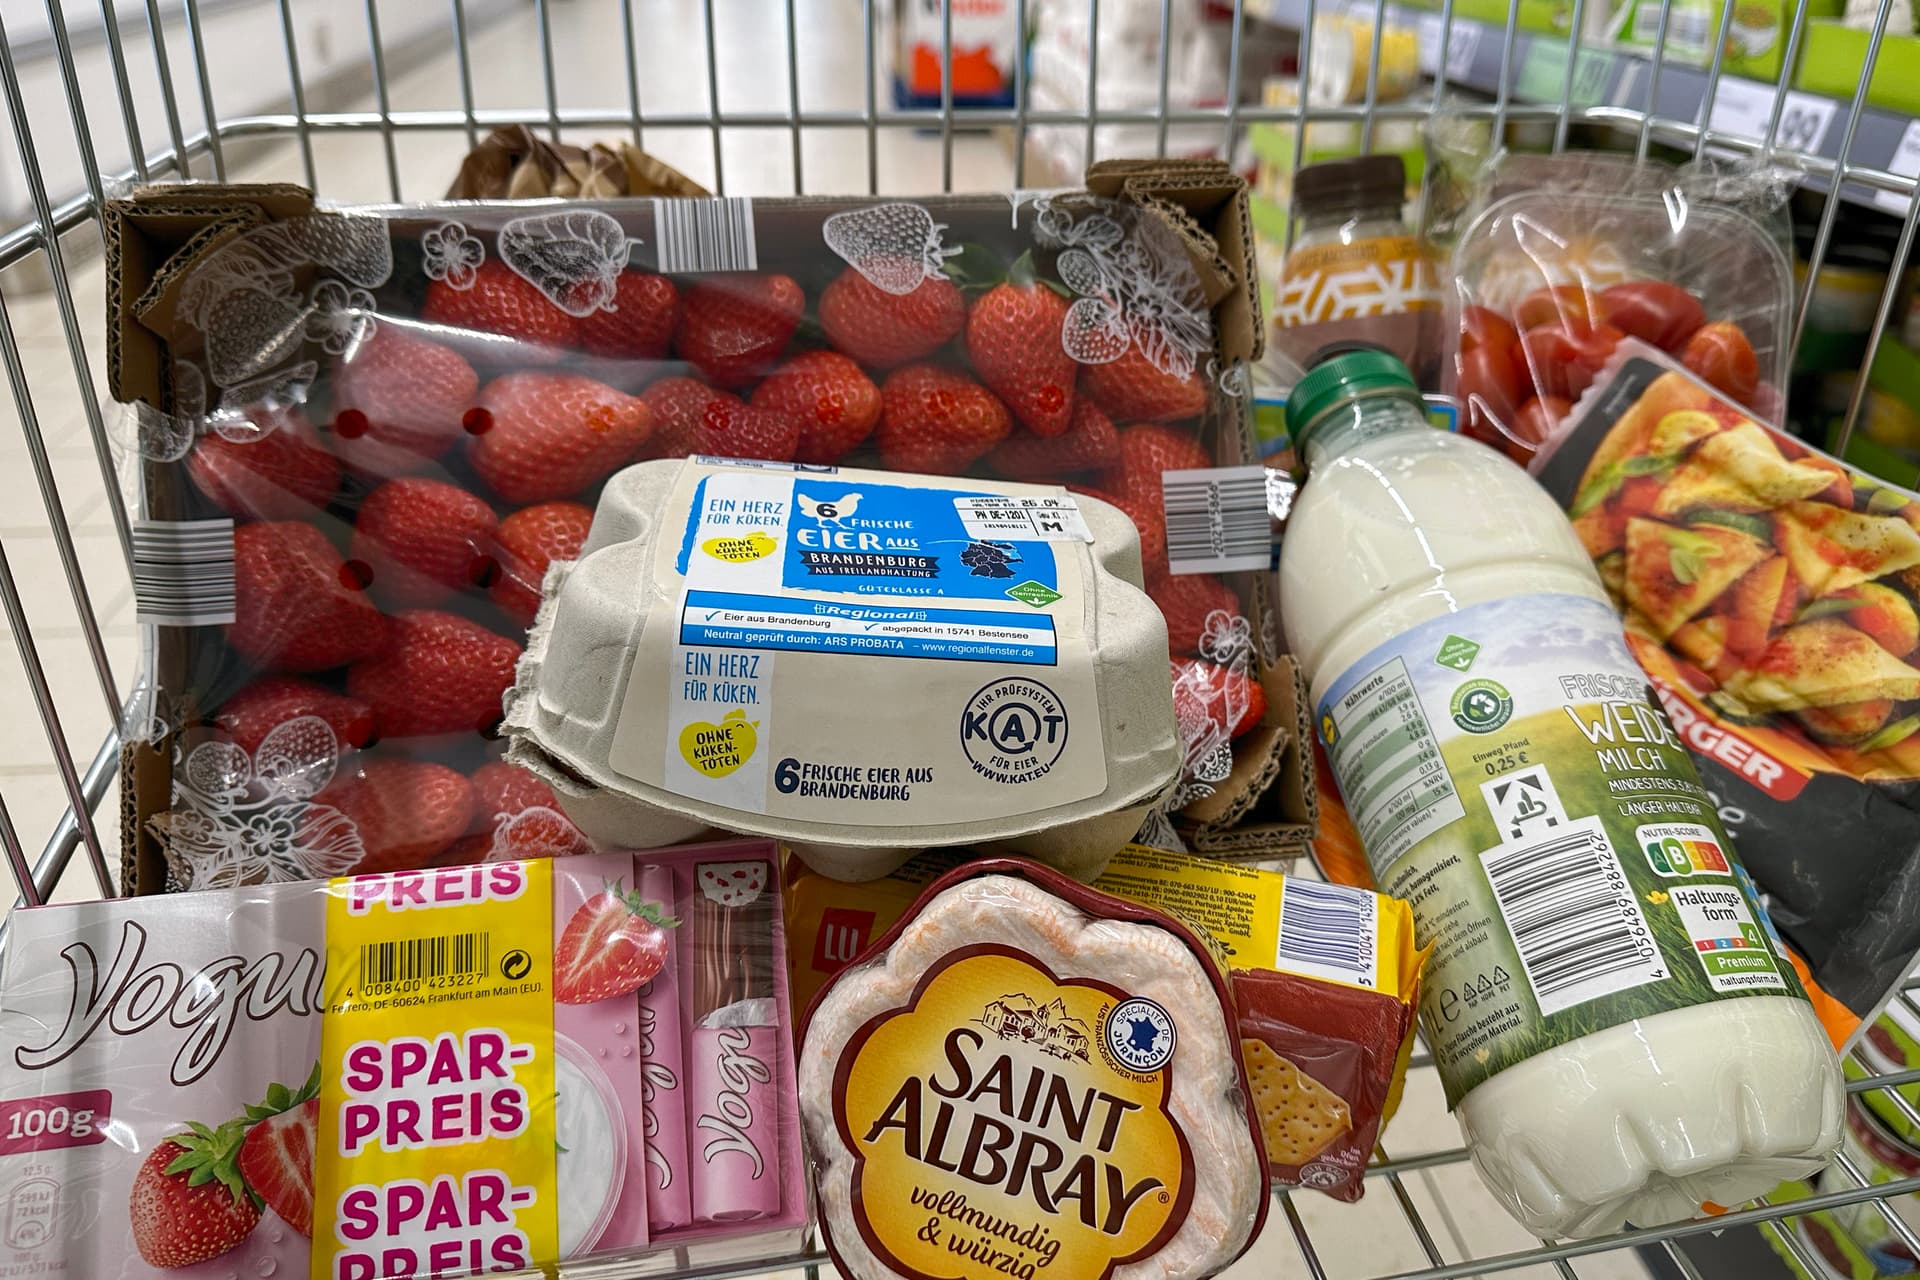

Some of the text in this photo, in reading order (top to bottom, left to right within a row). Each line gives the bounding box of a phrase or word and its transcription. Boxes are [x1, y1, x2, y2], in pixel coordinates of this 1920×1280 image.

[710, 499, 784, 514] EIN HERZ
[816, 503, 838, 518] 6
[707, 513, 783, 527] FÜR KÜKEN.
[851, 518, 914, 529] FRISCHE
[1041, 522, 1063, 532] M
[715, 545, 759, 555] KÜKEN-
[718, 539, 755, 548] OHNE
[797, 529, 919, 551] EIER AUS
[720, 552, 760, 560] TÖTEN
[810, 552, 927, 568] BRANDENBURG
[815, 567, 931, 578] AUS FREILANDHALTUNG
[858, 585, 932, 595] GÜTEKLASSE
[1011, 590, 1059, 599] Gentechnik
[724, 612, 744, 621] Eier
[767, 616, 832, 628] Brandenburg
[826, 607, 916, 620] Regional
[704, 629, 1034, 657] Neutral geprüft durch: ARS PROBATA www.regionalfenster.de
[882, 625, 1029, 640] abgepackt in 15741 Bestensee
[685, 652, 761, 679] EIN HERZ
[684, 679, 760, 705] FÜR KÜKEN.
[1344, 675, 1384, 710] Nährwerte
[1559, 673, 1648, 701] FRISCHE
[976, 684, 1056, 714] IHR PRÜFSYSTEM
[696, 728, 734, 745] OHNE
[965, 712, 1063, 744] KAT
[1563, 701, 1682, 752] WEIDE
[693, 742, 738, 759] KÜKEN-
[1472, 737, 1530, 763] Einweg Pfand
[1596, 747, 1667, 773] MILCH
[699, 753, 740, 771] TÖTEN
[972, 760, 1050, 784] WWW.KAT.EU
[989, 755, 1039, 770] FÜR EIER
[1484, 751, 1529, 775] 0,25 €
[774, 758, 801, 794] 6
[802, 763, 933, 784] FRISCHE EIER AUS
[800, 780, 910, 801] BRANDENBURG
[1608, 778, 1677, 792] MINDESTENS
[1618, 800, 1702, 816] LÄNGER HALTBAR
[1642, 827, 1702, 838] NUTRI-SCORE
[1654, 851, 1667, 866] A
[1669, 845, 1686, 865] B
[1704, 849, 1713, 862] D
[1408, 854, 1461, 890] homogenisiert,
[353, 862, 521, 910] PREIS
[1423, 883, 1440, 899] Fett,
[1194, 899, 1225, 911] Portugal.
[1590, 833, 1664, 978] 4 056489 884262
[1675, 891, 1741, 907] Haltungs-
[1702, 906, 1738, 921] form
[824, 923, 859, 961] LU
[1360, 929, 1373, 971] 410041
[1704, 929, 1758, 950] 1 2 3 4
[1716, 955, 1766, 969] Premium
[346, 973, 484, 998] 4 008400 423227
[1359, 977, 1372, 987] 5
[1719, 974, 1779, 986] haltungsform.de
[15, 920, 326, 1087] Yogu
[374, 996, 426, 1010] DE-60624
[428, 991, 473, 1004] Frankfurt
[475, 988, 490, 998] am
[493, 986, 518, 997] Main
[520, 983, 544, 995] (EU).
[1476, 1009, 1505, 1030] besteht
[1505, 1002, 1520, 1016] aus
[1487, 1014, 1524, 1039] Material.
[1095, 1002, 1159, 1084] AUS FRANZÖSISCHER MILCH
[1161, 1028, 1170, 1042] DE
[1113, 1030, 1165, 1067] JURANÇON
[347, 1034, 528, 1092] SPAR-
[928, 1028, 1143, 1153] SAINT
[7, 1108, 95, 1139] 100g
[345, 1088, 523, 1150] PREIS
[863, 1076, 1164, 1235] ALBRAY
[341, 1175, 530, 1240] SPAR-
[911, 1185, 1062, 1267] vollmundig
[339, 1234, 526, 1280] PREIS
[917, 1216, 1036, 1280] & würzig
